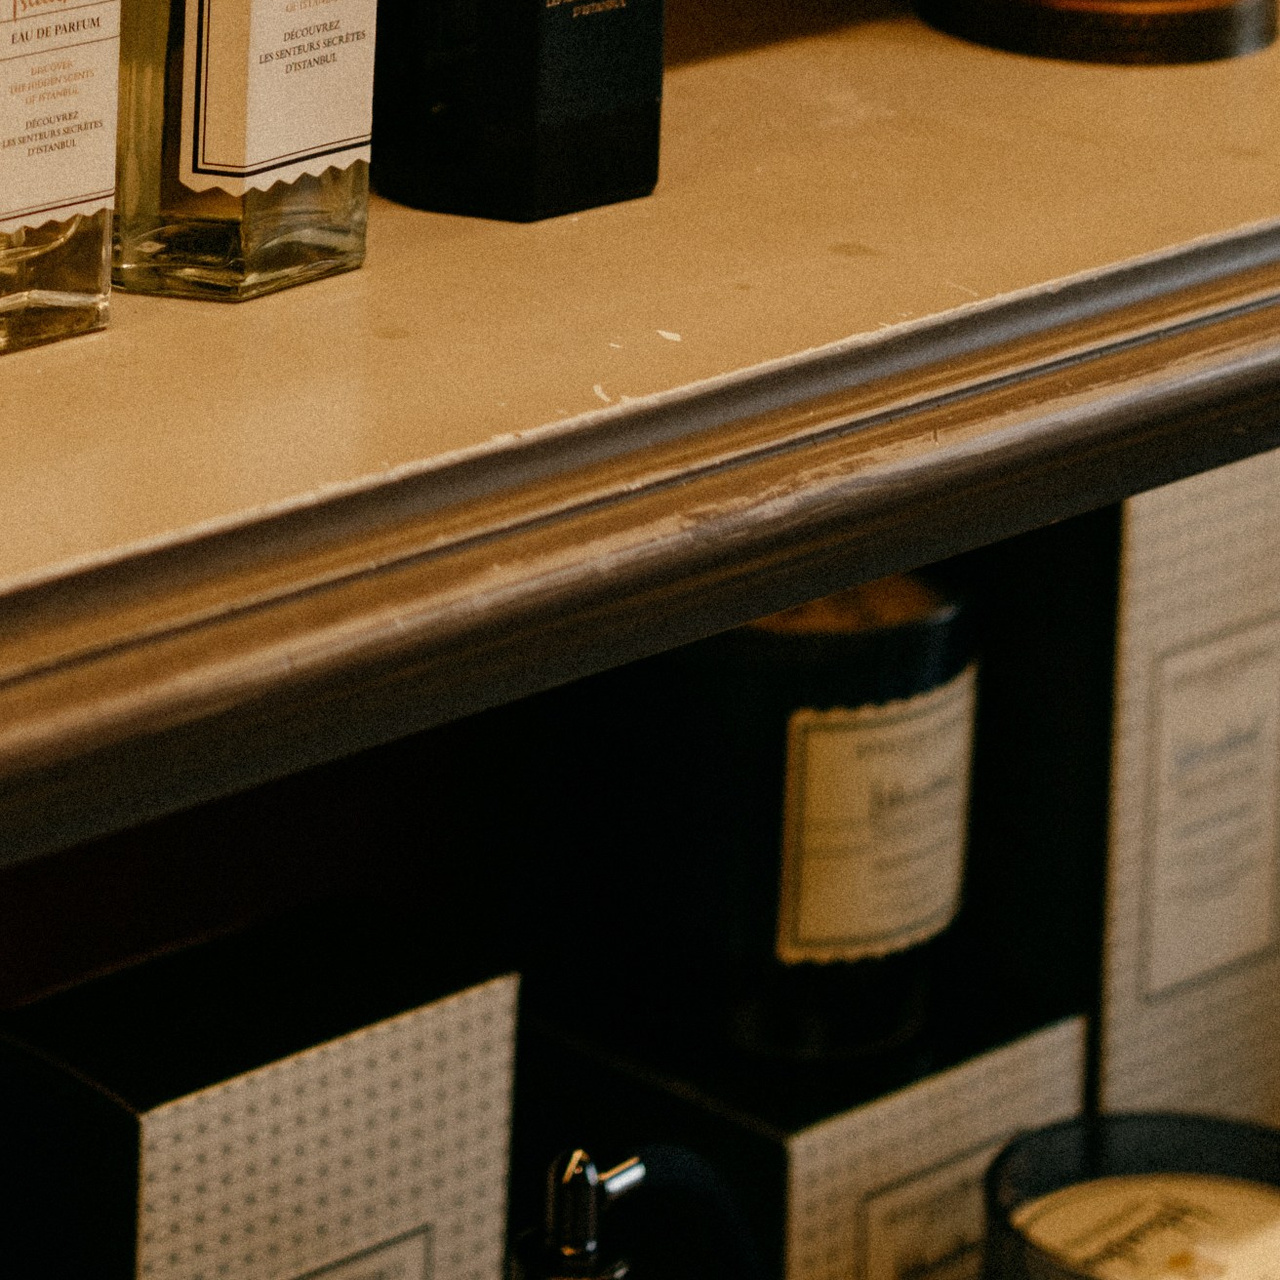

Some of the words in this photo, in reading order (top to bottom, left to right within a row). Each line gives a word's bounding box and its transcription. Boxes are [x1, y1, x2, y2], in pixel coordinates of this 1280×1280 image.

[11, 30, 33, 45] EAU
[37, 26, 53, 39] DE
[54, 17, 101, 35] PARFUM
[283, 19, 341, 42] DÉCOUVREZ
[259, 51, 274, 65] LES
[275, 40, 321, 61] SENTEURS
[322, 30, 366, 48] SECRÈTES
[285, 52, 337, 74] D'ISTANBUL
[25, 111, 79, 130] DÉCOUVREZ
[2, 138, 17, 149] LES
[17, 129, 61, 145] SENTEURS
[27, 139, 77, 157] D'ISTANBUL
